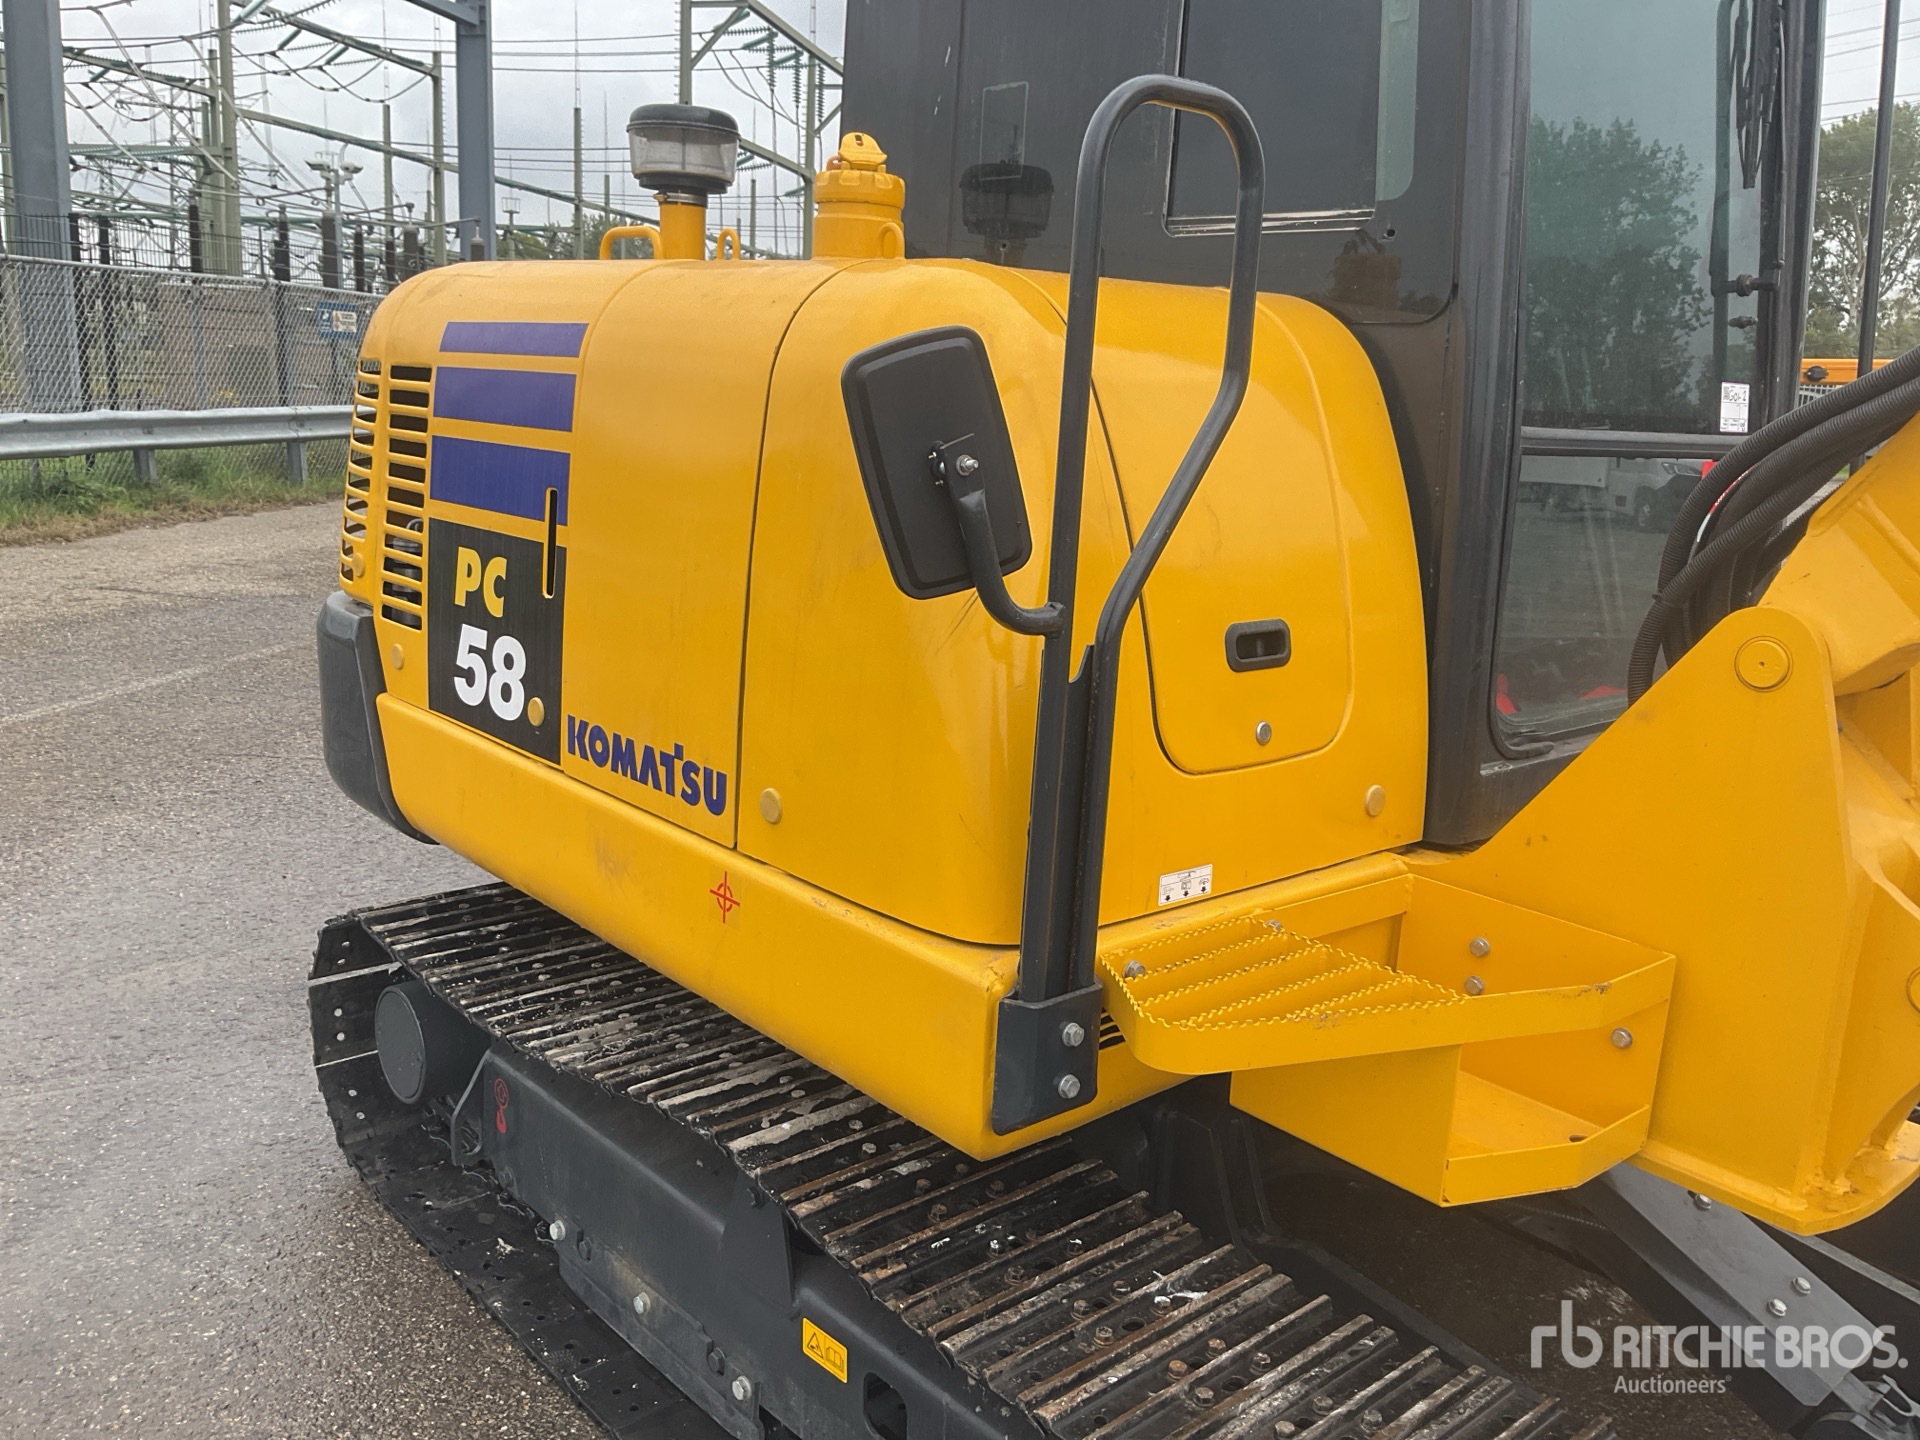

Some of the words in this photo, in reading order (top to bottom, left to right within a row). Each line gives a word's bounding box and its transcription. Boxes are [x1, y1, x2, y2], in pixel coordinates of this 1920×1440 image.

[454, 546, 507, 618] PC
[454, 623, 526, 721] 58
[567, 715, 727, 816] KOMATSU
